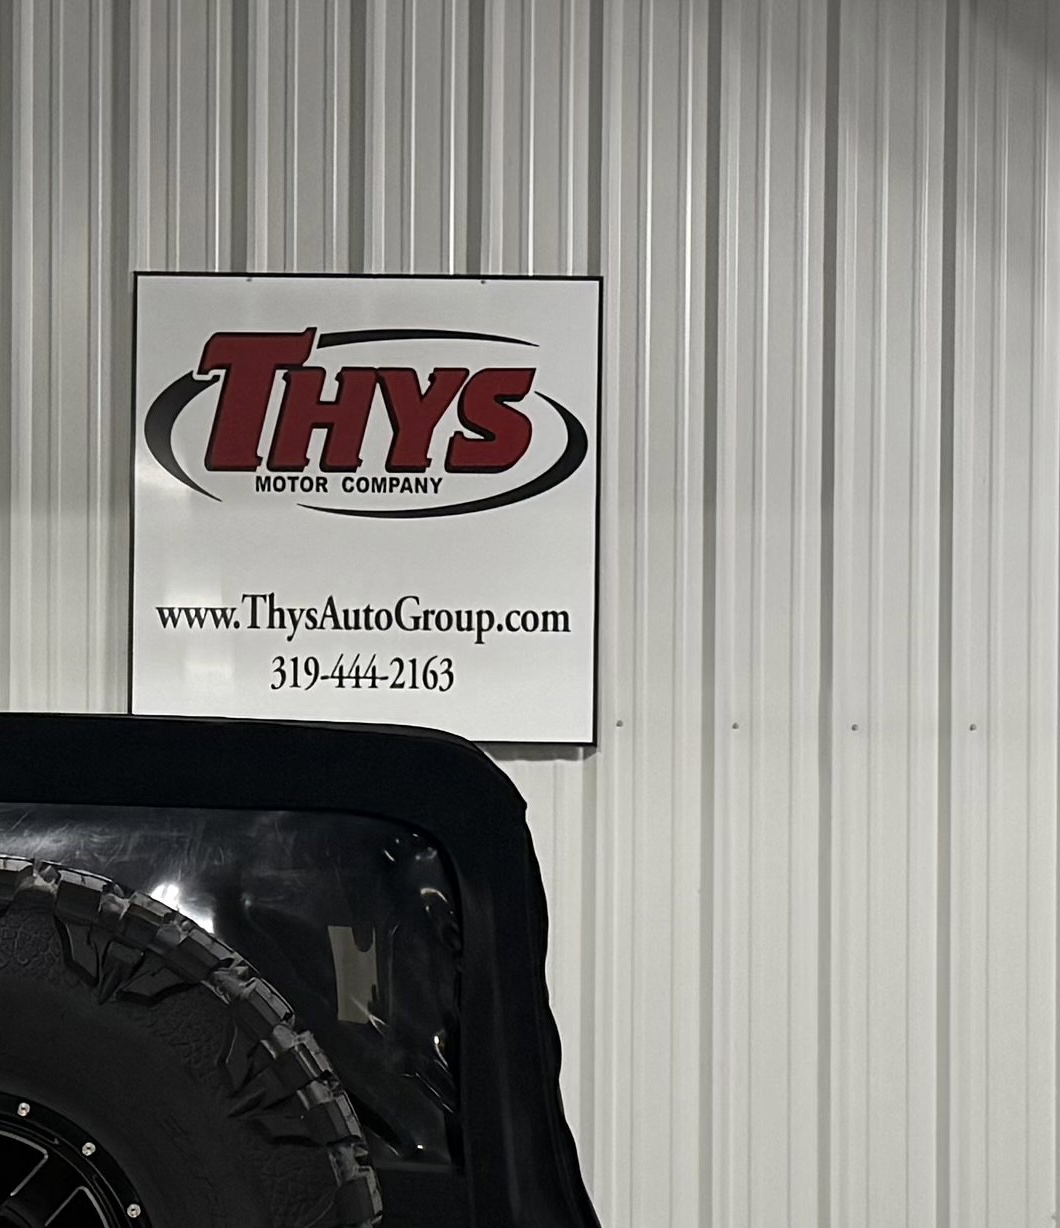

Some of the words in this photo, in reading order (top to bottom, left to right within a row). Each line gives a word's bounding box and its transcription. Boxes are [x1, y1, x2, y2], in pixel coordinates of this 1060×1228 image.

[197, 326, 537, 474] THYS
[255, 476, 328, 494] MOTOR
[341, 476, 443, 495] COMPANY
[155, 593, 571, 645] www.ThysAutoGroup.com
[270, 652, 455, 691] 319-444-2163
